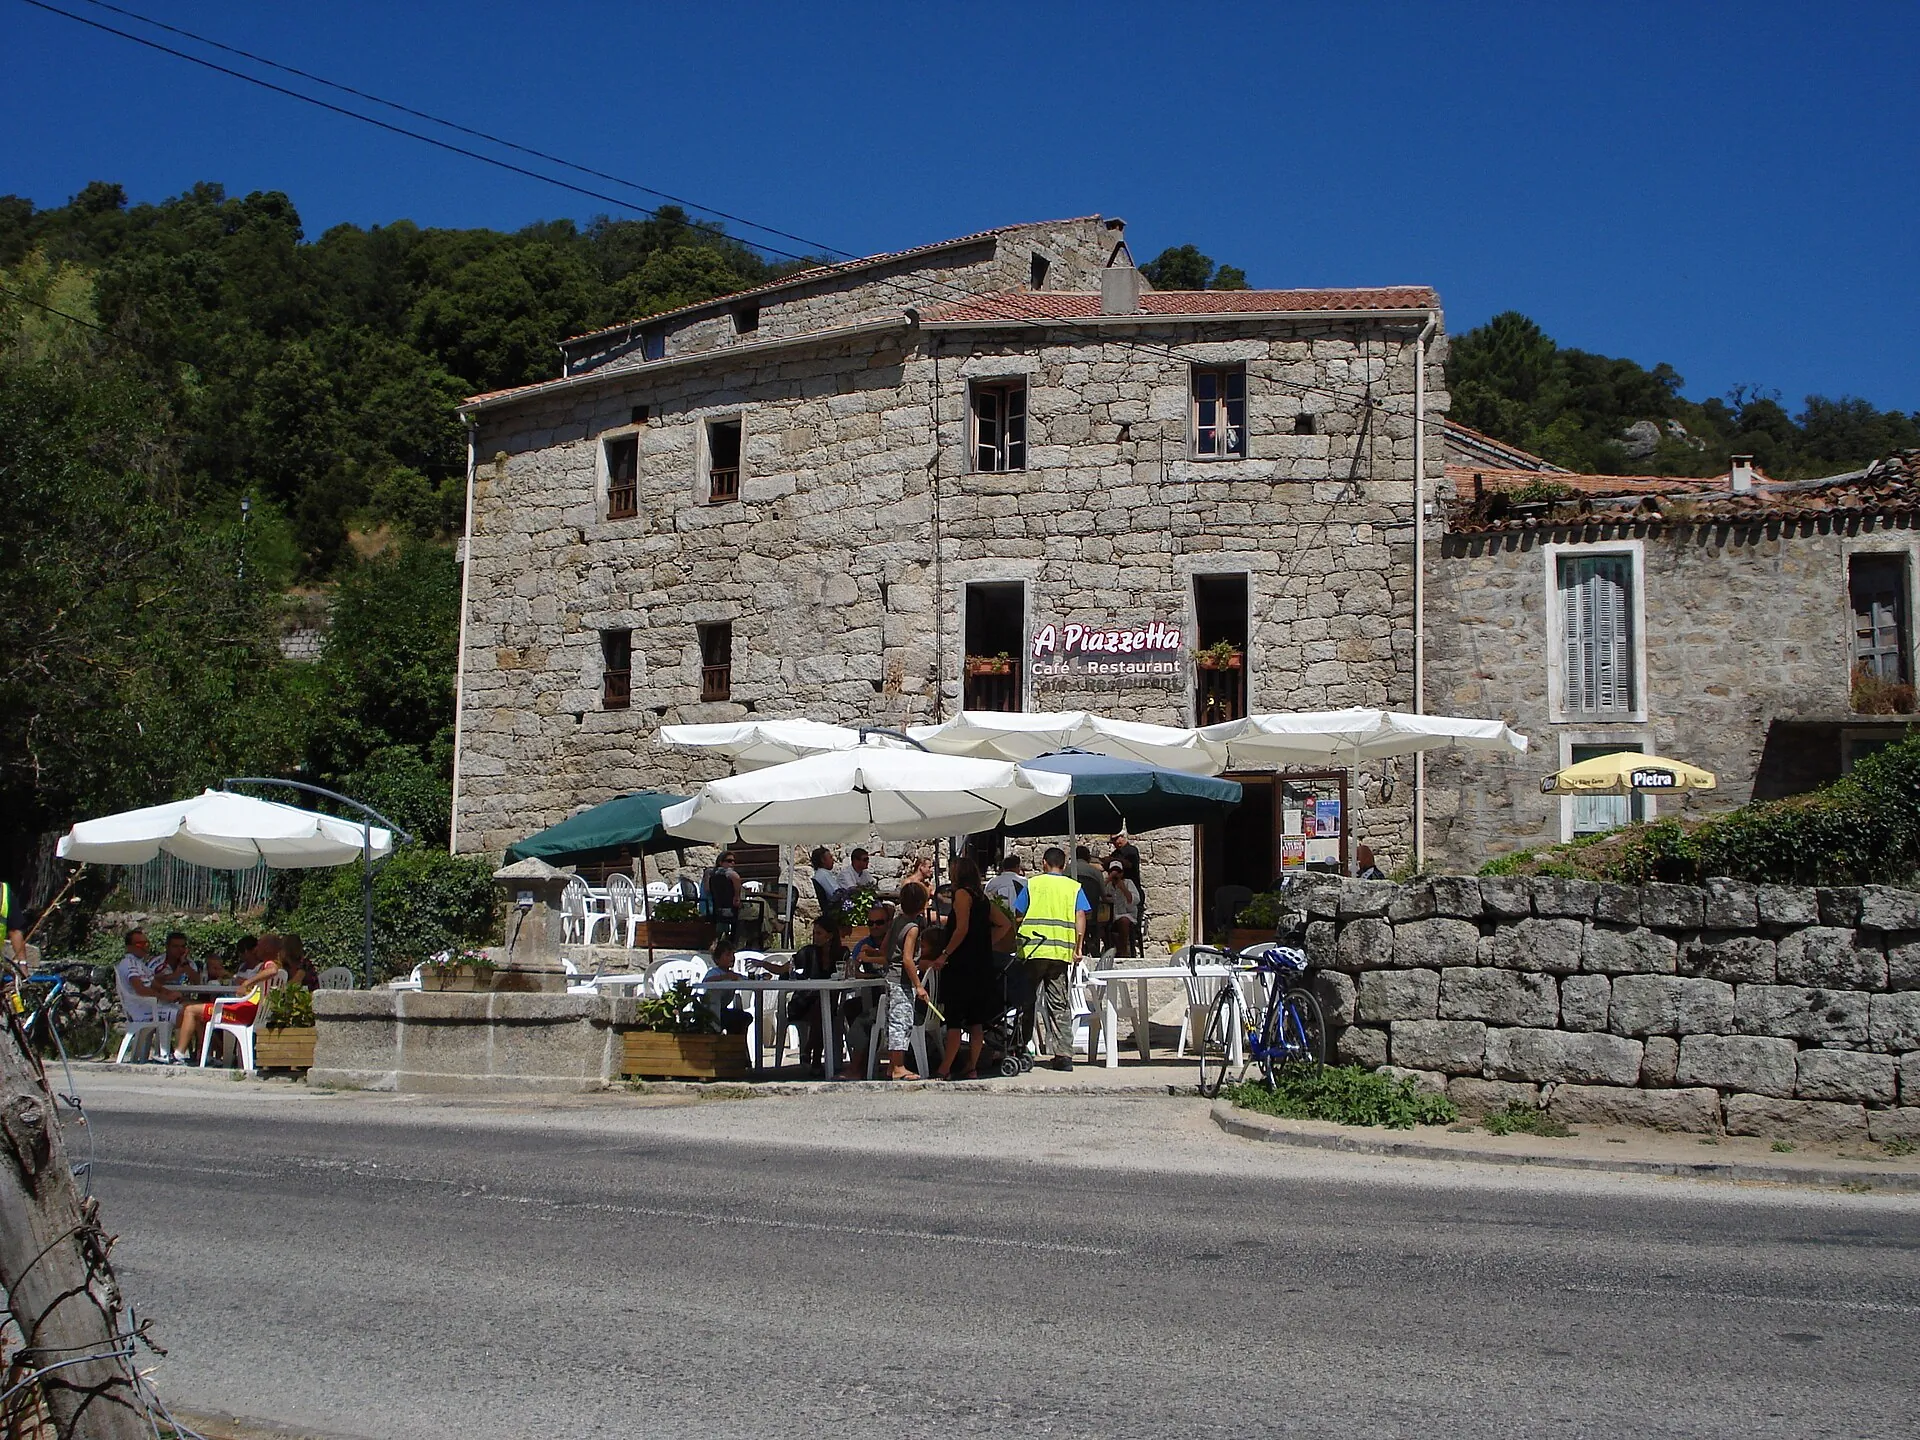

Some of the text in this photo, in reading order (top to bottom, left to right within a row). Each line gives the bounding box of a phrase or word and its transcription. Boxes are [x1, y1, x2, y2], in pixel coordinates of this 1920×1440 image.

[1033, 621, 1182, 657] A Piazzetta
[1031, 661, 1070, 675] Café
[1088, 659, 1181, 674] Restaurant
[1633, 771, 1672, 786] Pietra
